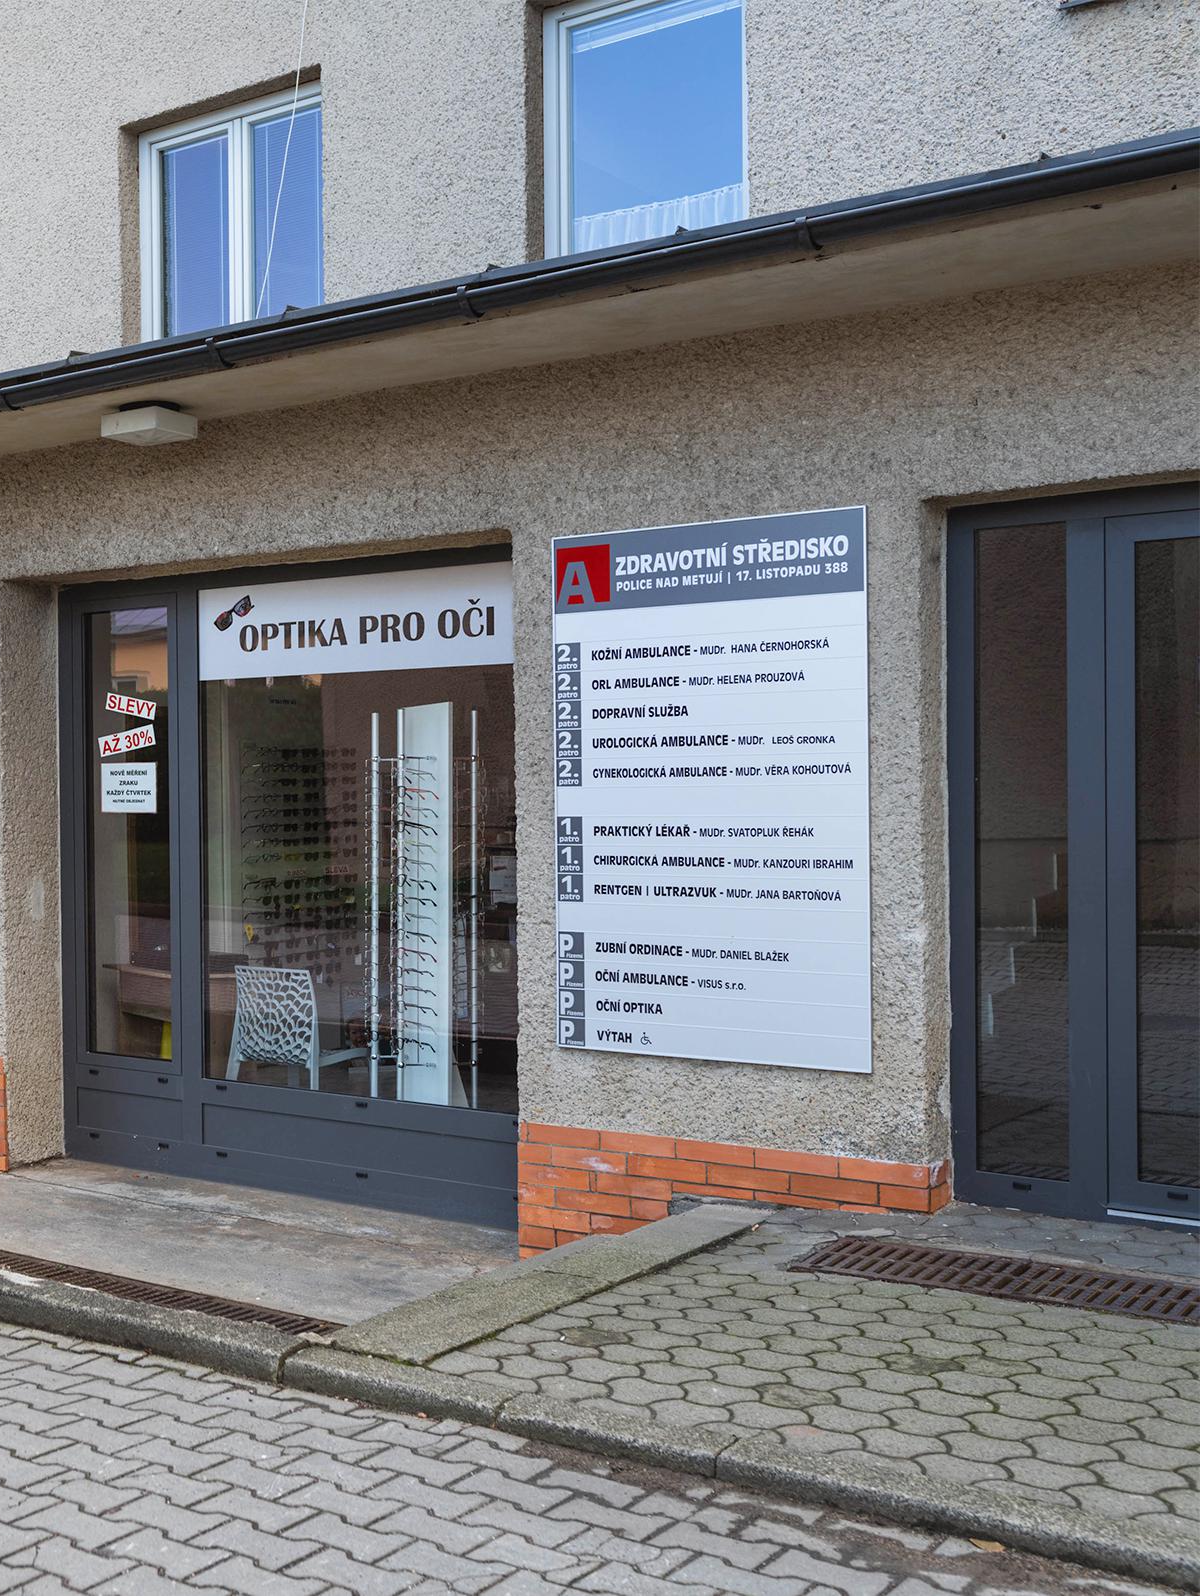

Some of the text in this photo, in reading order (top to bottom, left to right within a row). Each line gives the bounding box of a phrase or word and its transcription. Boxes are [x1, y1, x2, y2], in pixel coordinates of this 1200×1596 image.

[615, 535, 848, 576] ZDRAVOTNÍ STŘEDISKO
[557, 561, 596, 606] A
[616, 579, 652, 592] POLICE
[656, 577, 679, 589] NAD
[683, 571, 723, 586] METUJÍ
[736, 570, 752, 582] 17.
[756, 564, 820, 580] LISTOPADU
[825, 562, 848, 574] 388
[239, 598, 495, 652] OPTIKA PRO OČI
[558, 645, 578, 662] 2.
[592, 646, 622, 660] KOŽNÍ
[625, 645, 690, 659] AMBULANCE
[700, 646, 726, 655] MUDr.
[731, 644, 757, 653] HANA
[760, 637, 829, 652] ČERNOHORSKÁ
[558, 674, 578, 691] 2.
[592, 679, 611, 690] ORL
[614, 676, 679, 689] AMBULANCE
[689, 676, 714, 686] MUDr.
[717, 674, 752, 684] HELENA
[755, 670, 804, 683] PROUZOVÁ
[108, 695, 154, 717] SLEVY
[558, 703, 578, 720] 2.
[593, 704, 688, 719] DOPRAVNÍ SLUŽBA
[103, 730, 152, 755] AŽ 30%
[559, 732, 579, 748] 2.
[592, 735, 657, 748] UROLOGICKÁ
[661, 735, 728, 747] AMBULANCE
[738, 736, 764, 745] MUDr.
[772, 735, 794, 744] LEOŠ
[797, 736, 835, 744] GRONKA
[559, 760, 579, 777] 2.
[593, 766, 666, 778] GYNEKOLOGICKÁ
[669, 766, 727, 777] AMBULANCE
[736, 767, 762, 776] MUDr.
[765, 765, 789, 775] VĚRA
[792, 762, 851, 774] KOHOUTOVÁ
[561, 818, 578, 835] 1.
[594, 824, 652, 837] PRAKTICKÝ
[656, 824, 690, 837] LÉKAŘ
[700, 828, 725, 837] MUDr.
[728, 828, 779, 837] SVATOPLUK
[783, 826, 814, 837] ŘEHÁK
[562, 847, 578, 864] 1.
[594, 855, 658, 866] CHIRURGICKÁ
[662, 857, 725, 867] AMBULANCE
[734, 858, 760, 868] MUDr.
[763, 859, 810, 869] KANZOURI
[813, 859, 853, 869] IBRAHIM
[562, 875, 578, 893] 1.
[594, 884, 642, 896] RENTGEN
[654, 886, 716, 898] ULTRAZVUK
[727, 889, 752, 899] MUDr.
[756, 890, 780, 900] JANA
[783, 890, 841, 901] BARTOŇOVÁ
[595, 941, 626, 954] ZUBNÍ
[629, 944, 683, 956] ORDINACE
[692, 949, 718, 959] MUDr.
[720, 950, 752, 960] DANIEL
[755, 950, 789, 962] BLAŽEK
[595, 969, 620, 983] OČNÍ
[622, 973, 688, 987] AMBULANCE
[698, 979, 723, 989] VISUS
[725, 982, 746, 991] s.r.o.
[596, 999, 663, 1015] OČNÍ OPTIKA
[597, 1029, 632, 1043] VÝTAH
